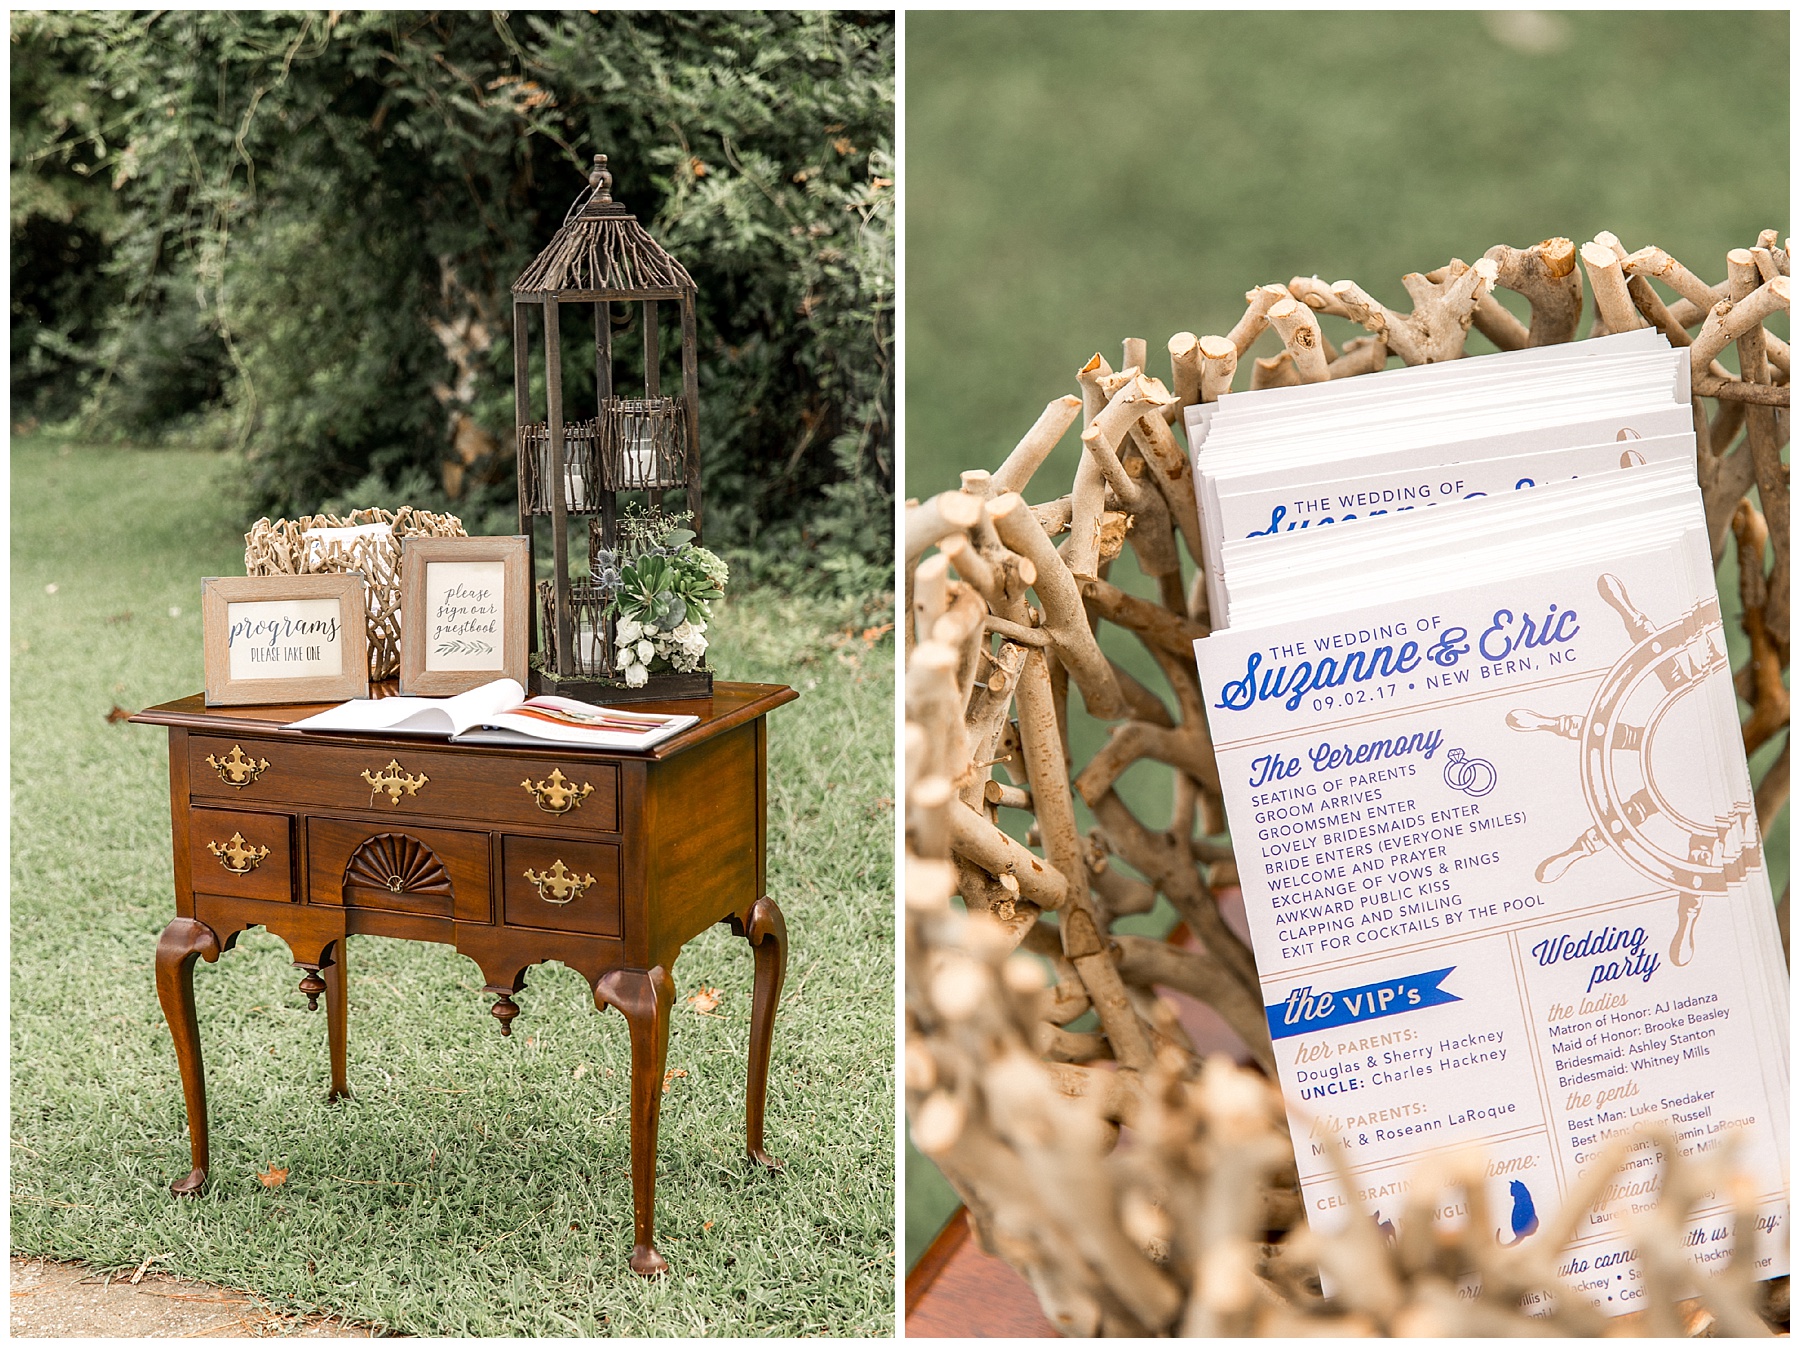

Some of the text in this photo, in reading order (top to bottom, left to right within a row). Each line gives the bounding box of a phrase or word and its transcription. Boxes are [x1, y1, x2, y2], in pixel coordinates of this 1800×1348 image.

[1294, 480, 1465, 514] THE WEDDING OF
[436, 603, 498, 622] sign our
[444, 582, 492, 605] please
[228, 616, 342, 648] programs
[433, 618, 497, 640] guestbook
[1269, 616, 1442, 660] THE WEDDING OF
[250, 645, 321, 662] PLEASE TAKE ONE
[1214, 603, 1581, 712] Suzanne & Eric
[1313, 648, 1578, 712] 09.02.17 NEW BERN, NC
[1248, 729, 1444, 788] The Ceremony
[1251, 764, 1417, 808] SEATING OF PARENTS
[1255, 788, 1383, 824] GROOM ARRIVES
[1258, 799, 1417, 841] GROOMSMEN ENTER
[1261, 803, 1480, 858] LOVELY BRIDESMAIDS ENTER
[1265, 811, 1527, 875] BRIDE ENTERS (EVERYONE SMILES)
[1267, 845, 1447, 892] WELCOME AND PRAYER
[1271, 850, 1501, 909] EXCHANGE OF VOWS & RINGS
[1275, 879, 1451, 925] AWKWARD PUBLIC KISS
[1278, 894, 1463, 942] CLAPPING AND SMILING
[1281, 894, 1545, 959] EXIT FOR COCKTAILS BY THE POOL
[1531, 926, 1649, 967] Wedding
[1586, 948, 1661, 993] party
[1284, 984, 1421, 1026] the VIP's
[1547, 992, 1629, 1022] the ladies
[1549, 1021, 1598, 1038] Matron
[1595, 1015, 1607, 1027] of
[1610, 1007, 1651, 1024] Honor:
[1655, 1001, 1671, 1014] AJ
[1294, 1028, 1418, 1066] her PARENTS:
[1552, 1007, 1730, 1055] Maid of Honor: Brooke Beasley
[1555, 1028, 1716, 1071] Bridesmaid: Ashley Stanton
[1296, 1030, 1505, 1083] Douglas & Sherry Hackney
[1300, 1047, 1508, 1101] UNCLE: Charles Hackney
[1559, 1045, 1711, 1088] Bridesmaid: Whitney Mills
[1565, 1079, 1640, 1111] the gents
[1567, 1089, 1716, 1131] Best Man: Luke Snedaker
[1309, 1102, 1427, 1139] his PARENTS:
[1358, 1133, 1369, 1146] &
[1375, 1118, 1442, 1142] Roseann
[1448, 1102, 1517, 1127] LaRoque
[1571, 1133, 1598, 1148] Best
[1600, 1126, 1630, 1142] Man:
[1671, 1106, 1712, 1125] Russell
[1706, 1114, 1756, 1134] LaRoque
[1484, 1154, 1541, 1180] home:
[1557, 1257, 1590, 1278] who
[1710, 1227, 1729, 1242] us
